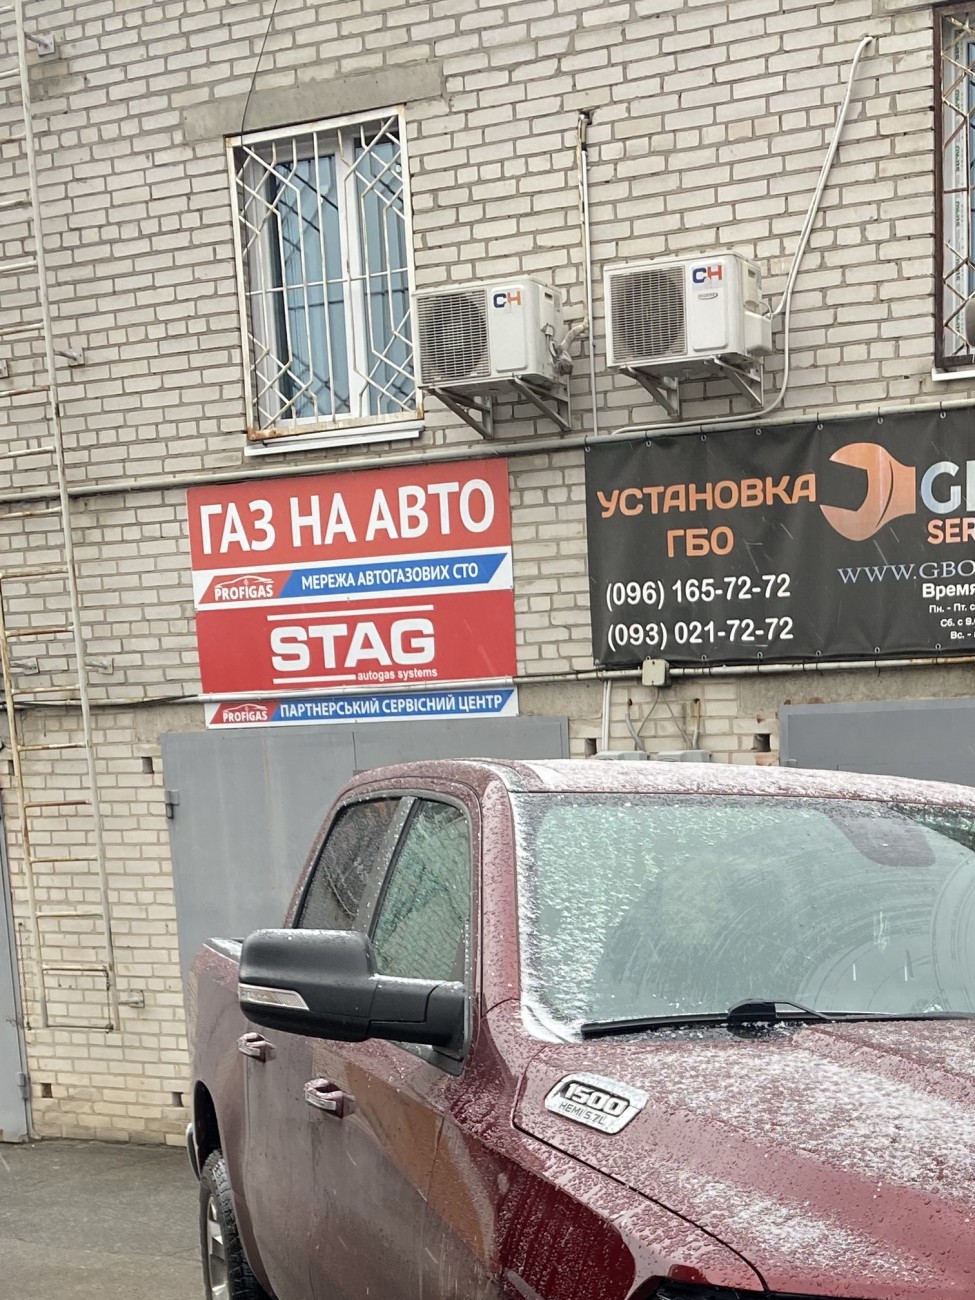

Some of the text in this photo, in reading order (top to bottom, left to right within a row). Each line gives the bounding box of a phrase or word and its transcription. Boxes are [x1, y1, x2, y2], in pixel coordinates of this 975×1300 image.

[692, 264, 723, 284] CH
[493, 290, 522, 309] CH
[596, 473, 816, 519] УСТАНОВКА
[199, 478, 495, 555] ГАЗ НА АВТО
[667, 525, 735, 558] ГБО
[301, 562, 479, 591] МЕРЕЖА АВТОГАЗОВИХ СТО
[214, 584, 274, 601] PROFIGAS
[605, 573, 791, 612] (096) 165-72-72
[929, 604, 945, 613] Пн.
[953, 603, 967, 612] Пт.
[969, 603, 975, 611] с
[957, 618, 963, 626] с
[270, 617, 436, 672] STAG
[607, 616, 794, 652] (093) 021-72-72
[950, 631, 965, 640] Вс.
[357, 667, 438, 683] autogas systems
[222, 710, 268, 723] PROFIGAS
[280, 694, 503, 718] ПАРТНЕРСЬКИЙ СЕРВІСНИЙ ЦЕНТР
[558, 1102, 583, 1116] HEMI
[564, 1082, 630, 1118] 1500
